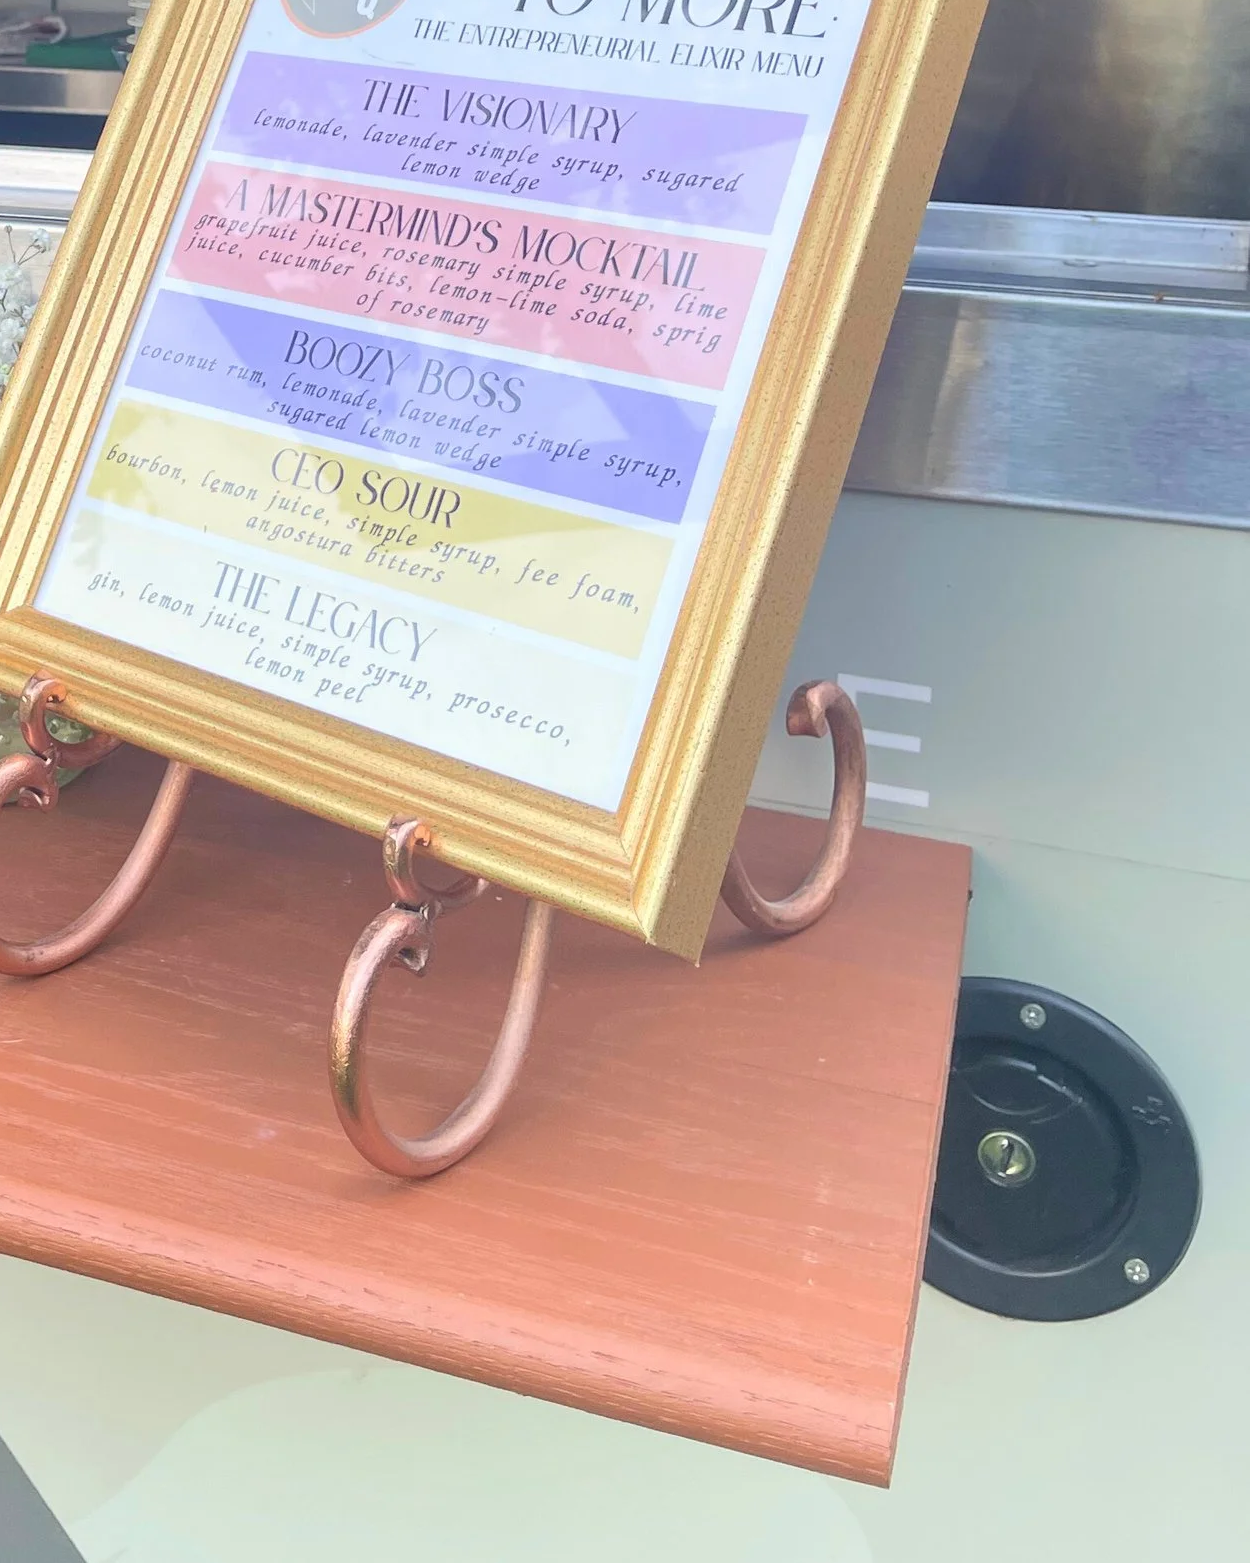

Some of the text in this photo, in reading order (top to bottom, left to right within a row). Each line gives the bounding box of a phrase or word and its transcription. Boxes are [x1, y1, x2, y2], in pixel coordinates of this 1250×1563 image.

[414, 18, 824, 78] THE ENTREPRENEURIAL ELIXIR MENU
[254, 109, 744, 192] lemonade, lavender simple syrup, sugared
[363, 79, 639, 144] THE VISIONARY
[399, 153, 540, 194] lemon wedge
[194, 214, 728, 320] grapefruit juice, rosemary simple syrup, lime
[225, 179, 705, 291] A MASTERMIND'S MOCKTAIL
[184, 232, 722, 353] juice, cucumber bits, lemon-lime soda, sprig
[356, 291, 490, 335] of rosemary
[284, 327, 525, 413] BOOZY BOSS
[141, 344, 681, 488] coconut rum, lemonade, lavender simple syrup,
[264, 401, 502, 470] sugared lemon wedge
[106, 445, 638, 614] bourbon, lemon juice, simple syrup, fee foam,
[272, 449, 460, 528] CEO SOUR
[246, 517, 445, 583] angostura bitters
[214, 561, 438, 661] THE LEGACY
[87, 574, 570, 747] gin, lemon juice, simple syrup, prosecco,
[245, 649, 375, 703] lemon peel
